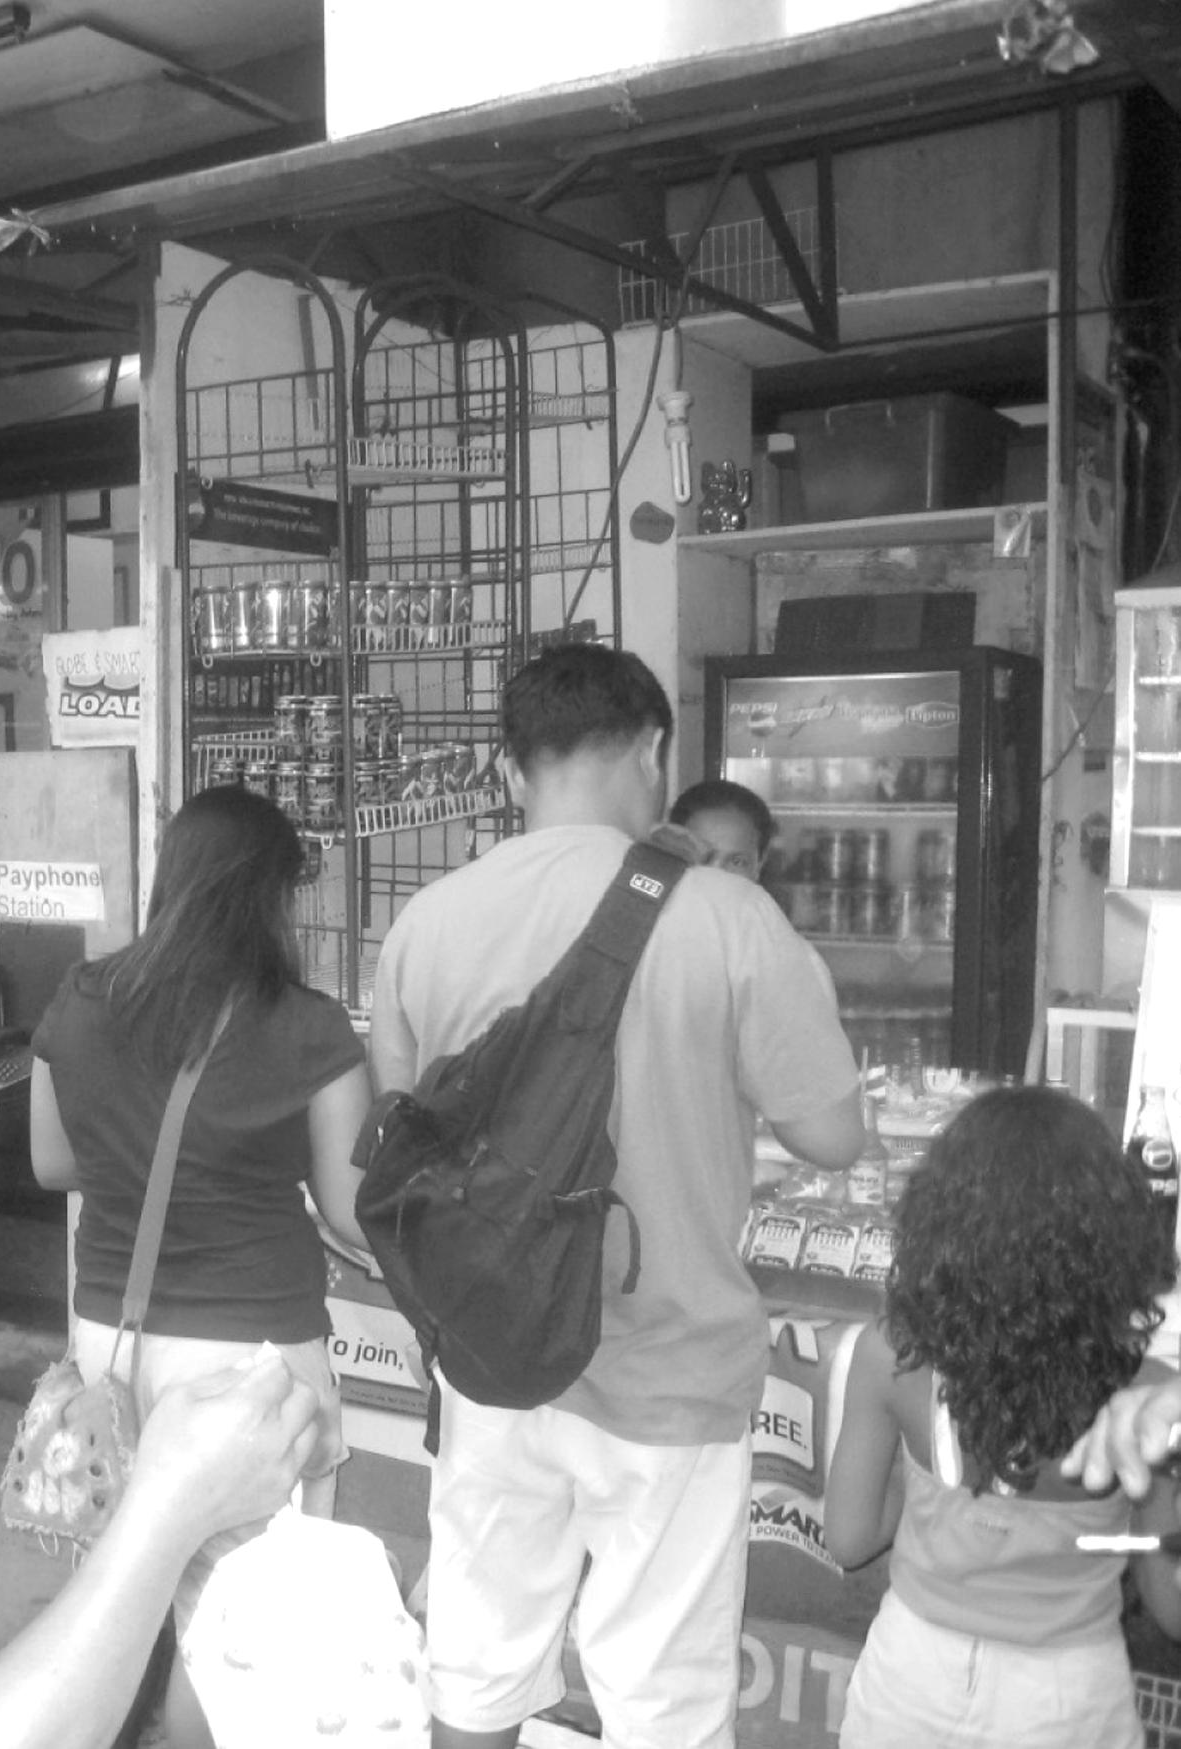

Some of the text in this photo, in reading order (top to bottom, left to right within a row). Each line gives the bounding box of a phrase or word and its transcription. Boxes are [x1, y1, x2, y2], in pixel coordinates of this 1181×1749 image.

[910, 706, 958, 725] Lipton
[353, 1337, 403, 1371] join,
[756, 1526, 799, 1543] POWER
